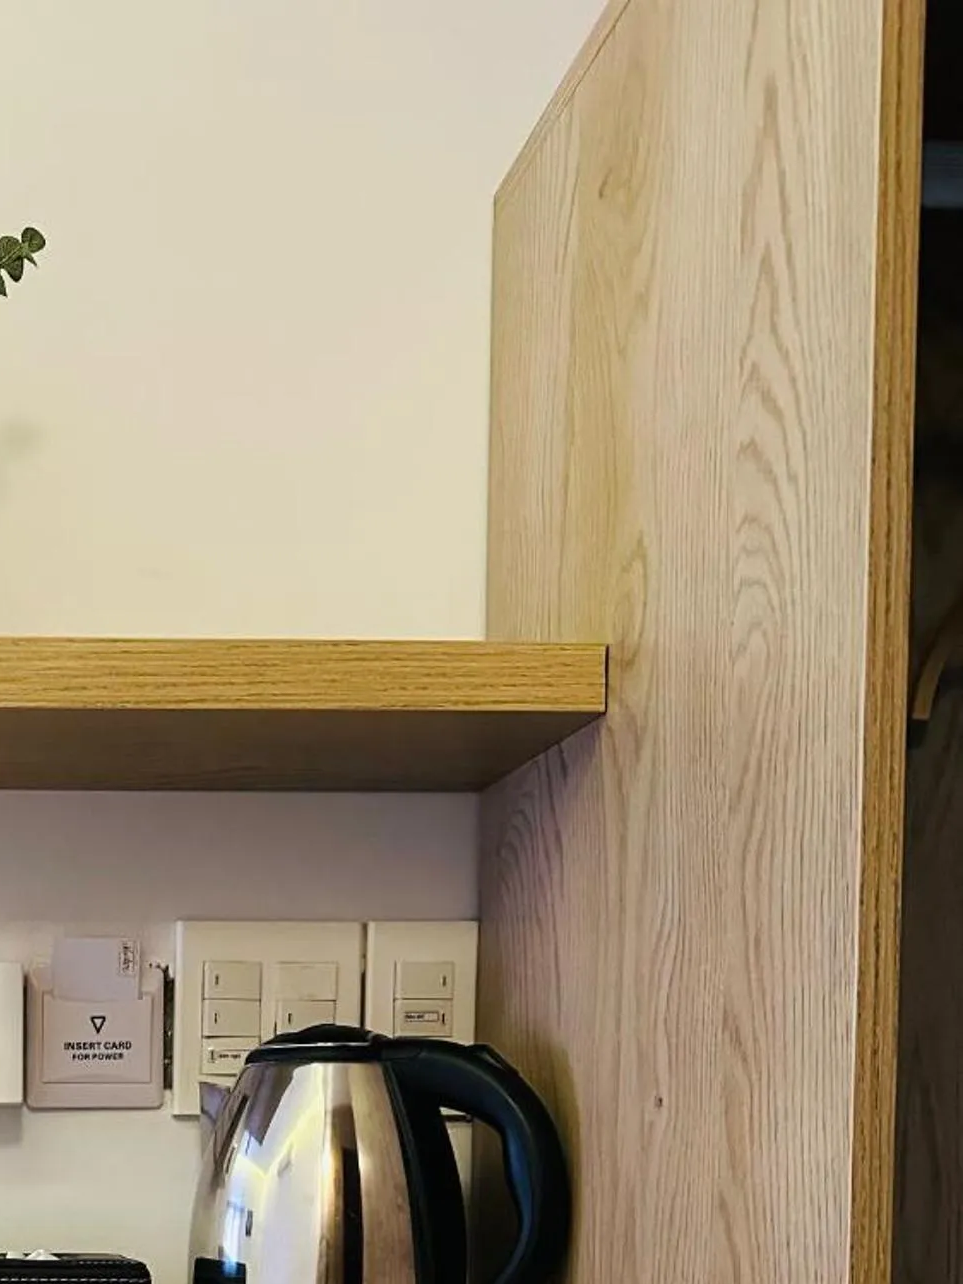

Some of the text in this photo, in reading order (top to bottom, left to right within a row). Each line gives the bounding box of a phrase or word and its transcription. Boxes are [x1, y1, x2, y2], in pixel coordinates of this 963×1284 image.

[63, 1041, 132, 1051] INSERT CARD
[71, 1052, 124, 1061] FOR POWER
